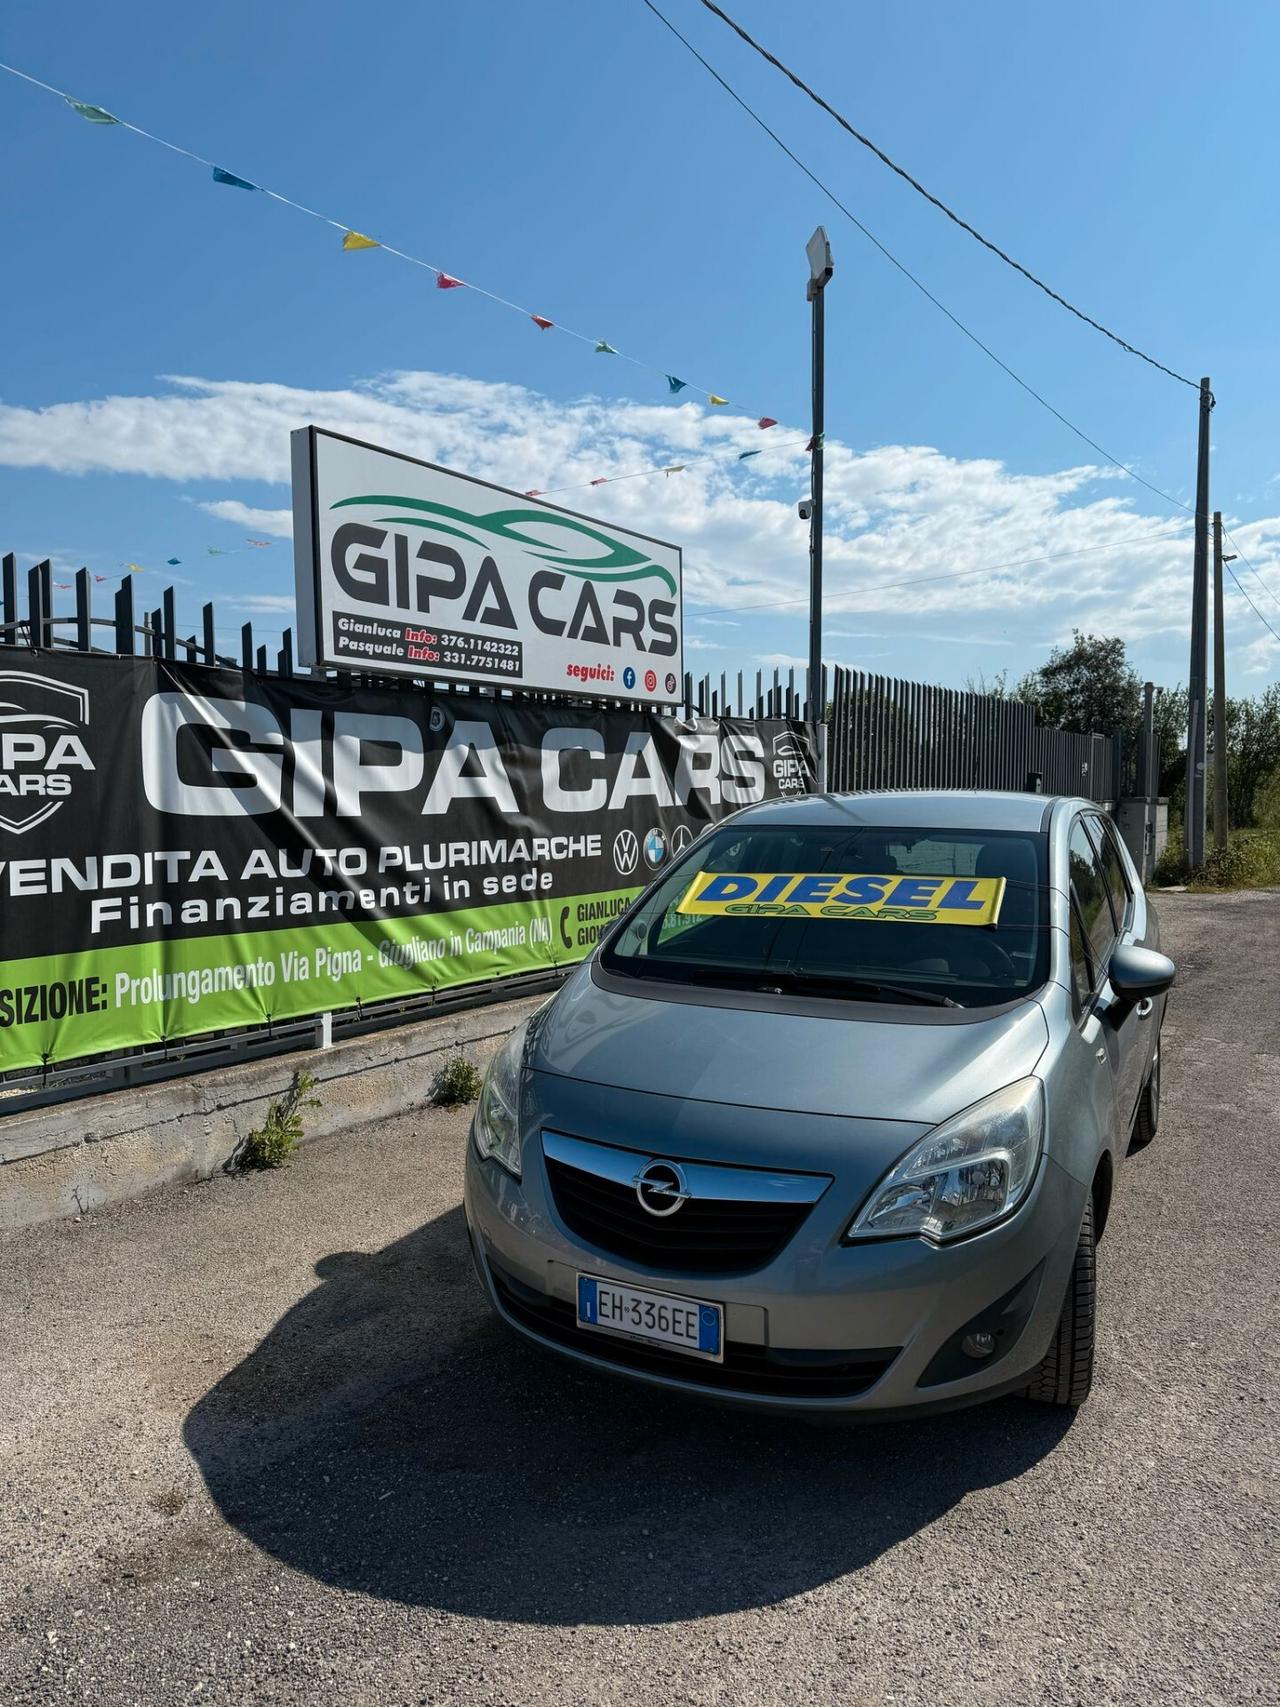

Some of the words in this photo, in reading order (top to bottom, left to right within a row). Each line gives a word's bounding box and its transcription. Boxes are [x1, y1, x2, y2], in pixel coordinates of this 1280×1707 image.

[331, 522, 518, 630] GIPA
[528, 570, 678, 657] CARS
[338, 617, 401, 639] Gianluca
[405, 627, 438, 645] Info:
[440, 634, 519, 657] 376.1142322
[338, 636, 405, 657] Pasquale
[407, 645, 440, 662] Info:
[443, 651, 520, 672] 331.7751481
[567, 663, 616, 682] seguici:
[141, 692, 520, 818] GIPA
[540, 727, 766, 813] CARS
[773, 759, 811, 778] GIPA
[778, 778, 805, 789] CARS
[0, 850, 229, 897] ENDITA
[240, 847, 368, 882] AUTO
[378, 834, 602, 874] PLURIMARCHE
[91, 883, 431, 934] Finanziamenti
[443, 876, 471, 900] in
[483, 868, 553, 893] sede
[577, 897, 631, 922] GIANLUCA
[695, 875, 985, 910] DIESEL
[725, 904, 812, 916] GIPA
[820, 906, 938, 921] CARS
[115, 961, 276, 1008] Prolungamento
[281, 950, 310, 983] Via
[315, 946, 362, 982] Pigna
[378, 930, 446, 970] Giugliano
[449, 929, 464, 953] in
[465, 918, 525, 958] Campania
[529, 917, 553, 949] (NA)
